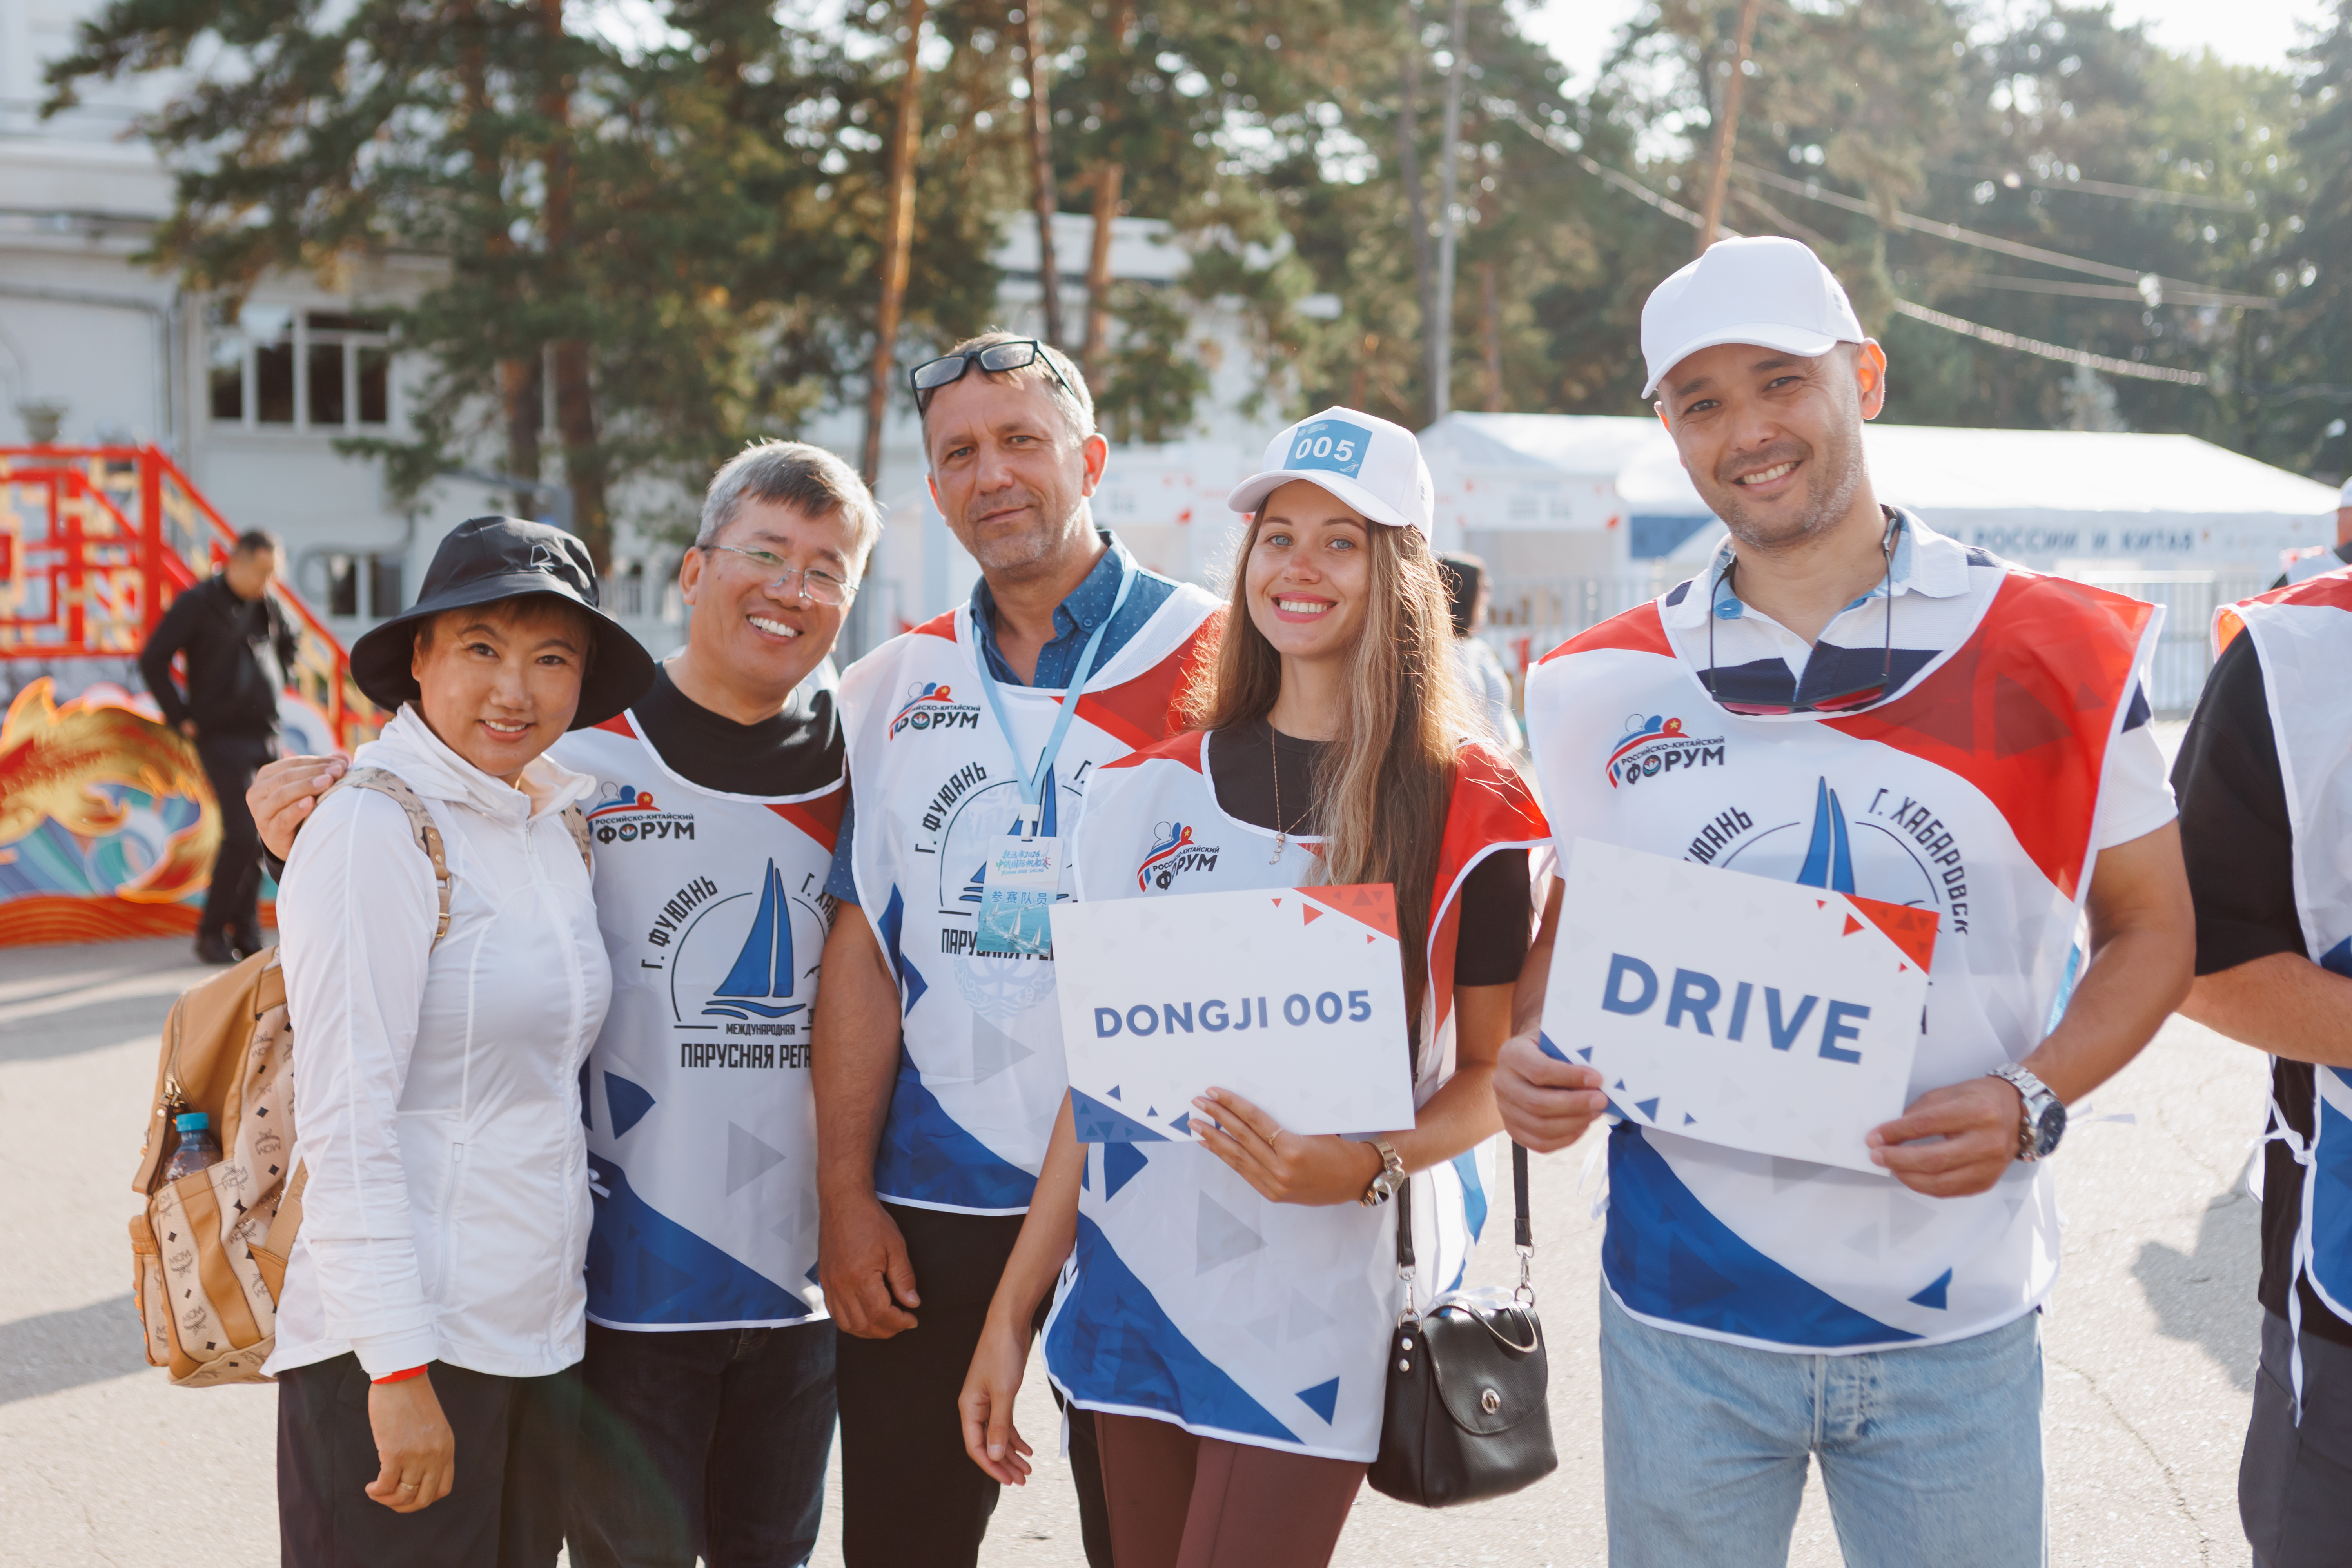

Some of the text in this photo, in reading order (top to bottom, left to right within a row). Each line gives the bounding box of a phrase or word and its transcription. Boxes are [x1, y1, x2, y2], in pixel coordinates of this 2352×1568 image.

[1295, 436, 1355, 462] 005
[1973, 528, 2079, 552] РОССИИ
[2091, 528, 2110, 552] И
[2121, 528, 2194, 553] КИТАЯ
[1073, 760, 1092, 784] Г.
[1627, 746, 1724, 785] ФОРУМ
[922, 761, 987, 832] ФУЮАНЬ
[595, 813, 694, 824] РОССИЙСКО-КИТАЙСКИЙ
[596, 821, 695, 844] ФОРУМ
[1684, 806, 1753, 866] ЮАНЬ
[915, 841, 937, 854] Г.
[1869, 788, 1969, 936] Г. ХАБАРОВСК
[991, 890, 1047, 905] 参赛队员
[641, 875, 718, 969] Г. ФУЮАНЬ
[1094, 990, 1372, 1039] DONGJI 005
[1601, 952, 1871, 1065] DRIVE
[726, 1024, 795, 1036] МЕЖДУНАРОДНАЯ
[681, 1044, 774, 1068] ПАРУСНАЯ
